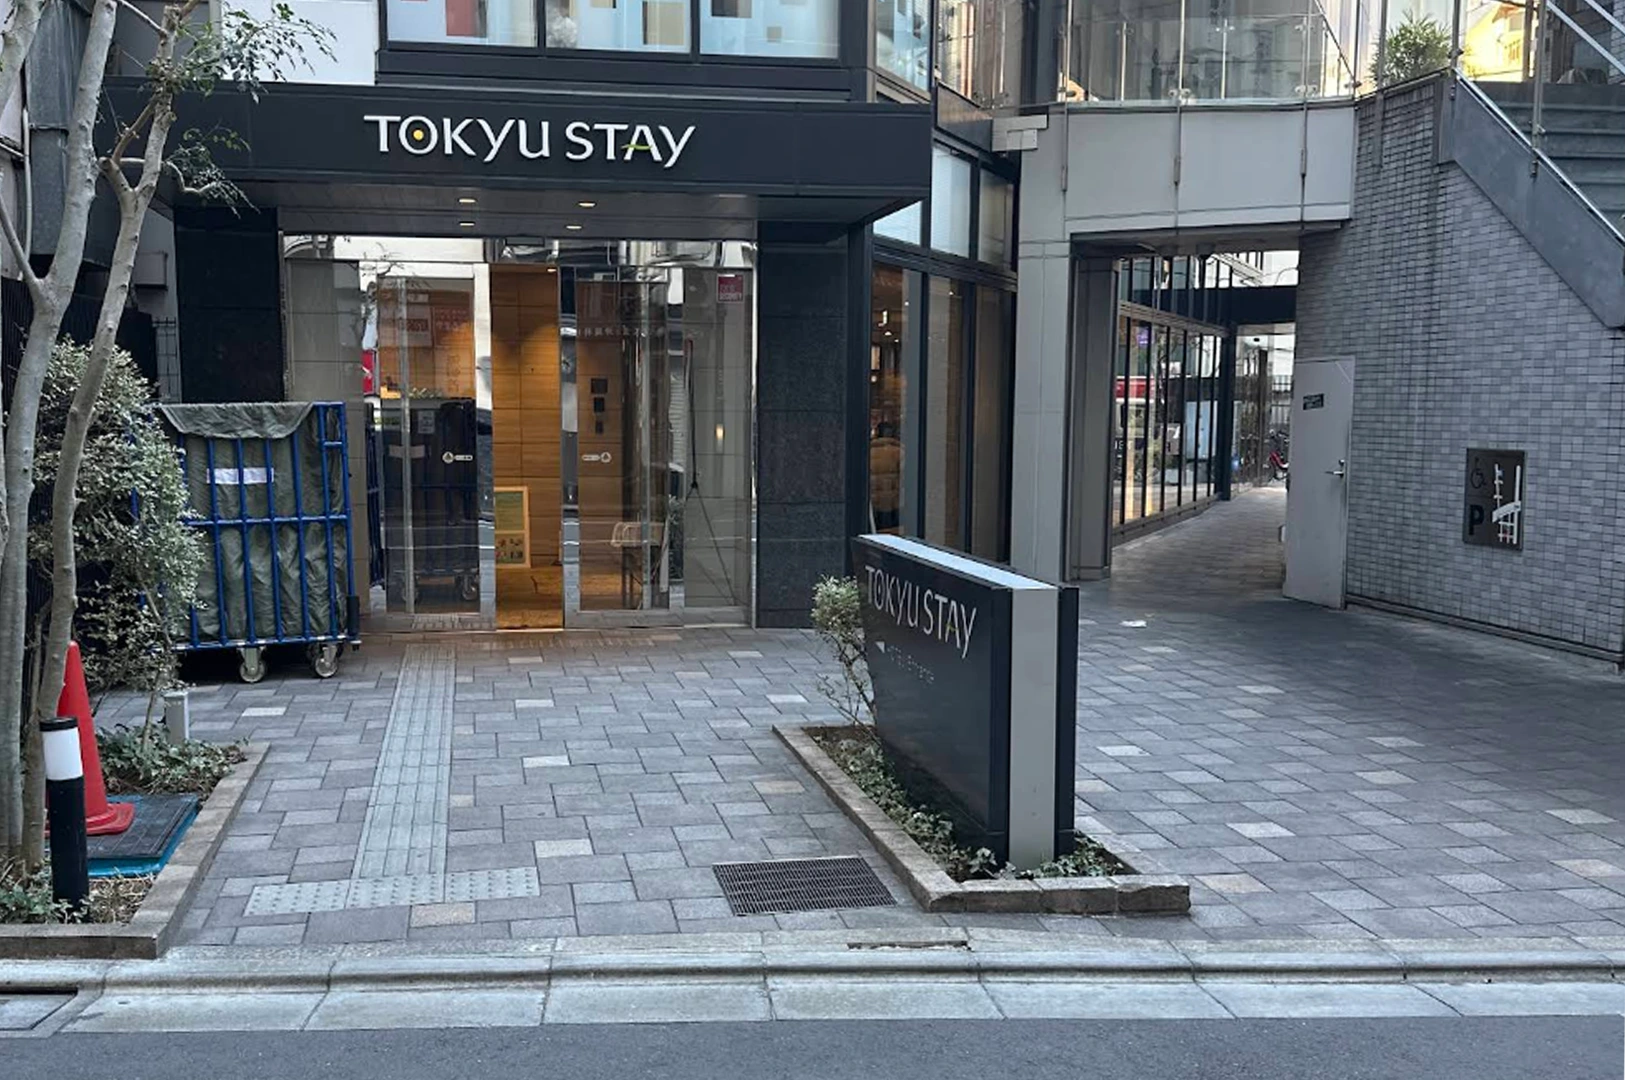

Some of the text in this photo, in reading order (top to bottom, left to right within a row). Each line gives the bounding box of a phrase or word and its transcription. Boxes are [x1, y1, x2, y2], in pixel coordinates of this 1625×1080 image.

[364, 114, 695, 168] TOKYU STAY
[1468, 504, 1485, 536] P
[865, 565, 976, 659] TOKYU STAY
